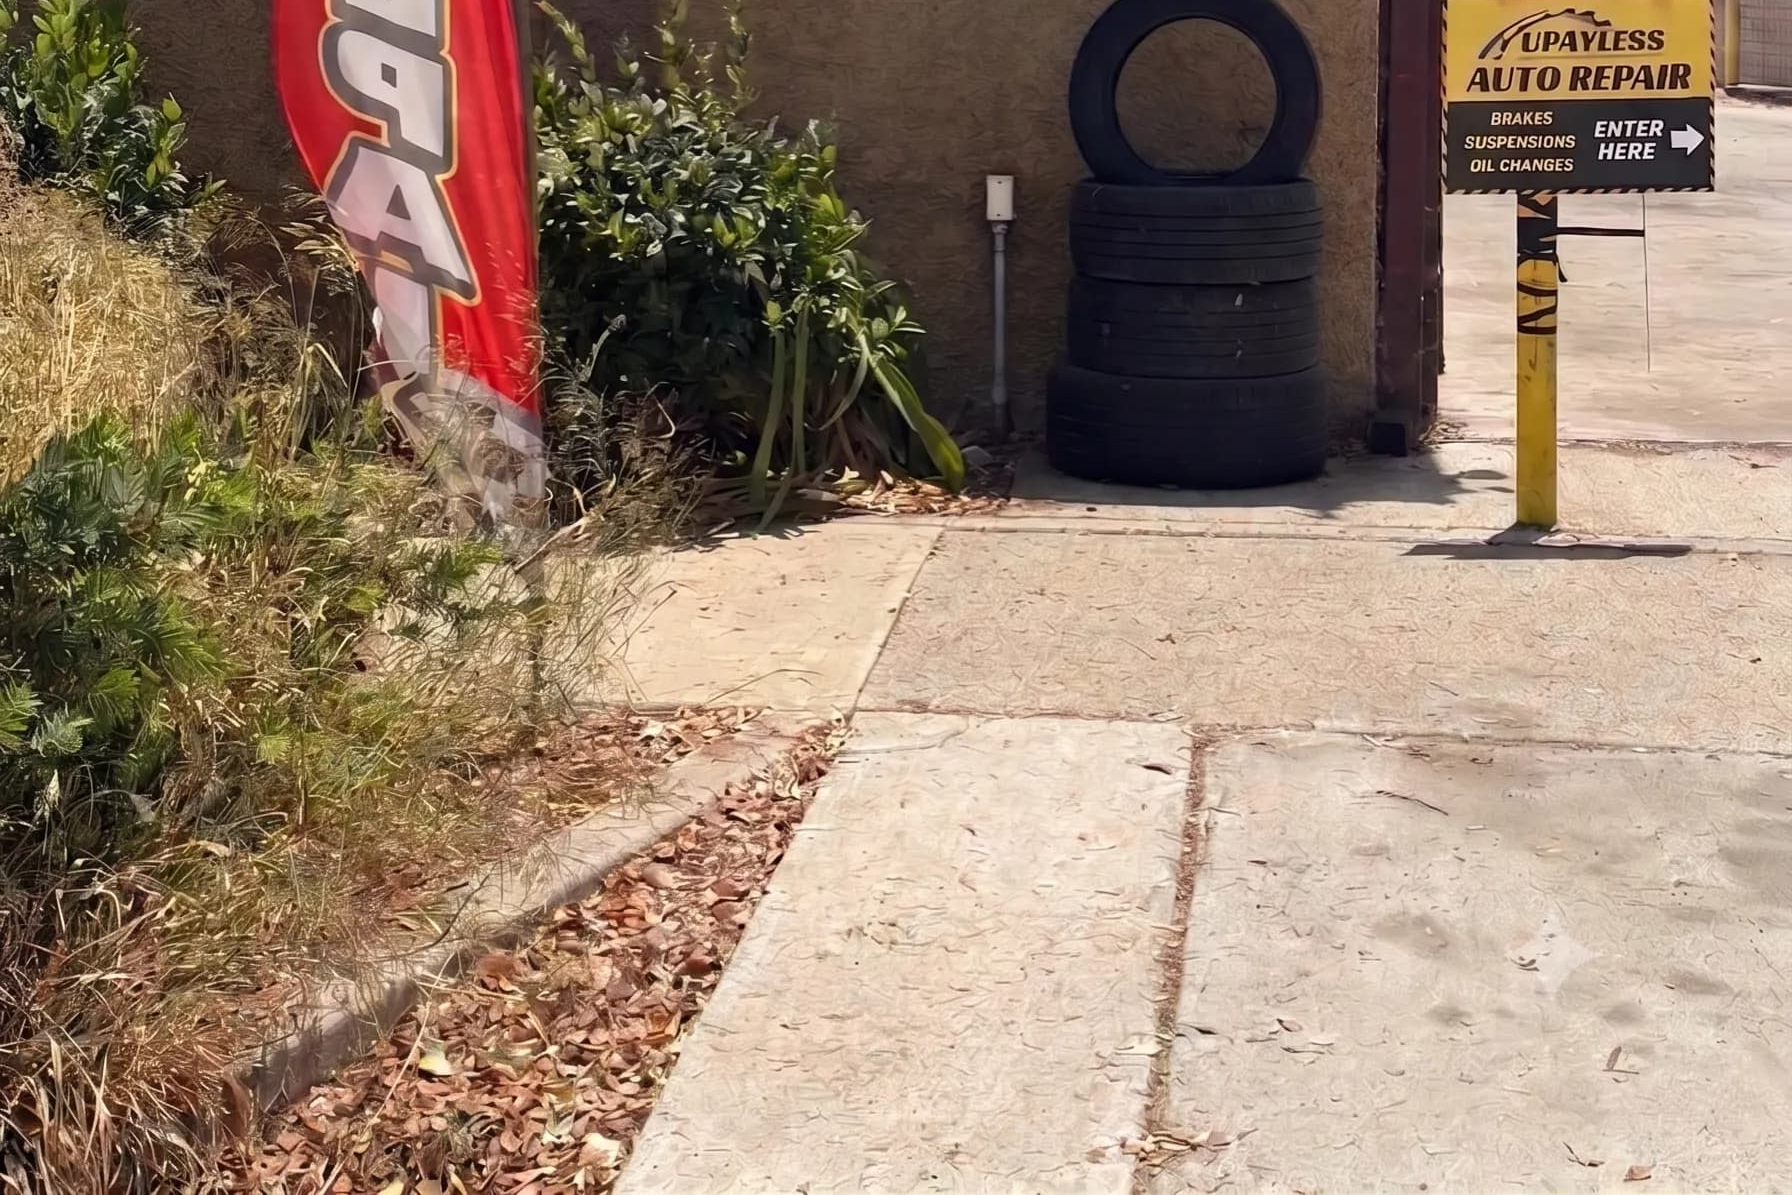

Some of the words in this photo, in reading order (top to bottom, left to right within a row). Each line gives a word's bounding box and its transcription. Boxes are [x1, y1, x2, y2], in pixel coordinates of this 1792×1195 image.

[1521, 29, 1666, 54] UPAYLESS
[1466, 66, 1562, 94] AUTO
[1568, 63, 1693, 93] REPAIR
[1490, 111, 1554, 127] BRAKES
[1593, 119, 1665, 139] ENTER
[1463, 134, 1577, 151] SUSPENSIONS
[1597, 142, 1657, 161] HERE
[1469, 159, 1496, 174] OIL
[1499, 158, 1575, 173] CHANGES
